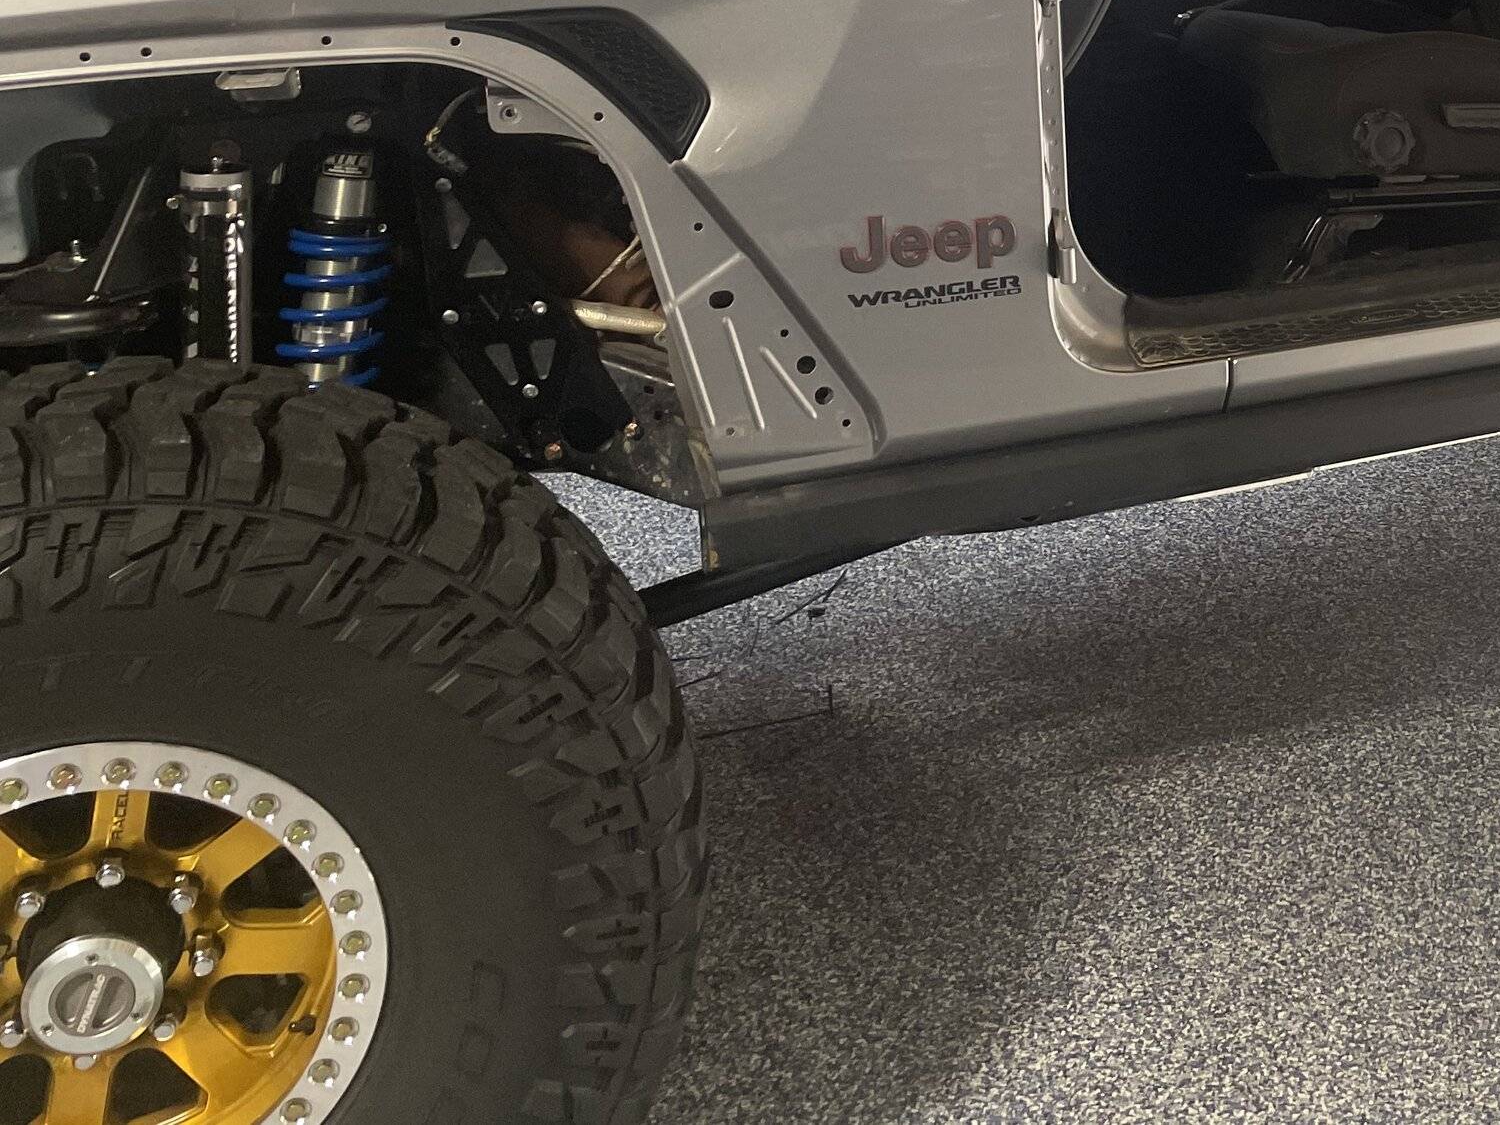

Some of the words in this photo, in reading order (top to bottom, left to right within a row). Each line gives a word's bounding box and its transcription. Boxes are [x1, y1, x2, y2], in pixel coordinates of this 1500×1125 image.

[839, 215, 1017, 274] Jeep
[848, 275, 1021, 308] WRANGLER
[905, 288, 1022, 309] UNLIMITED
